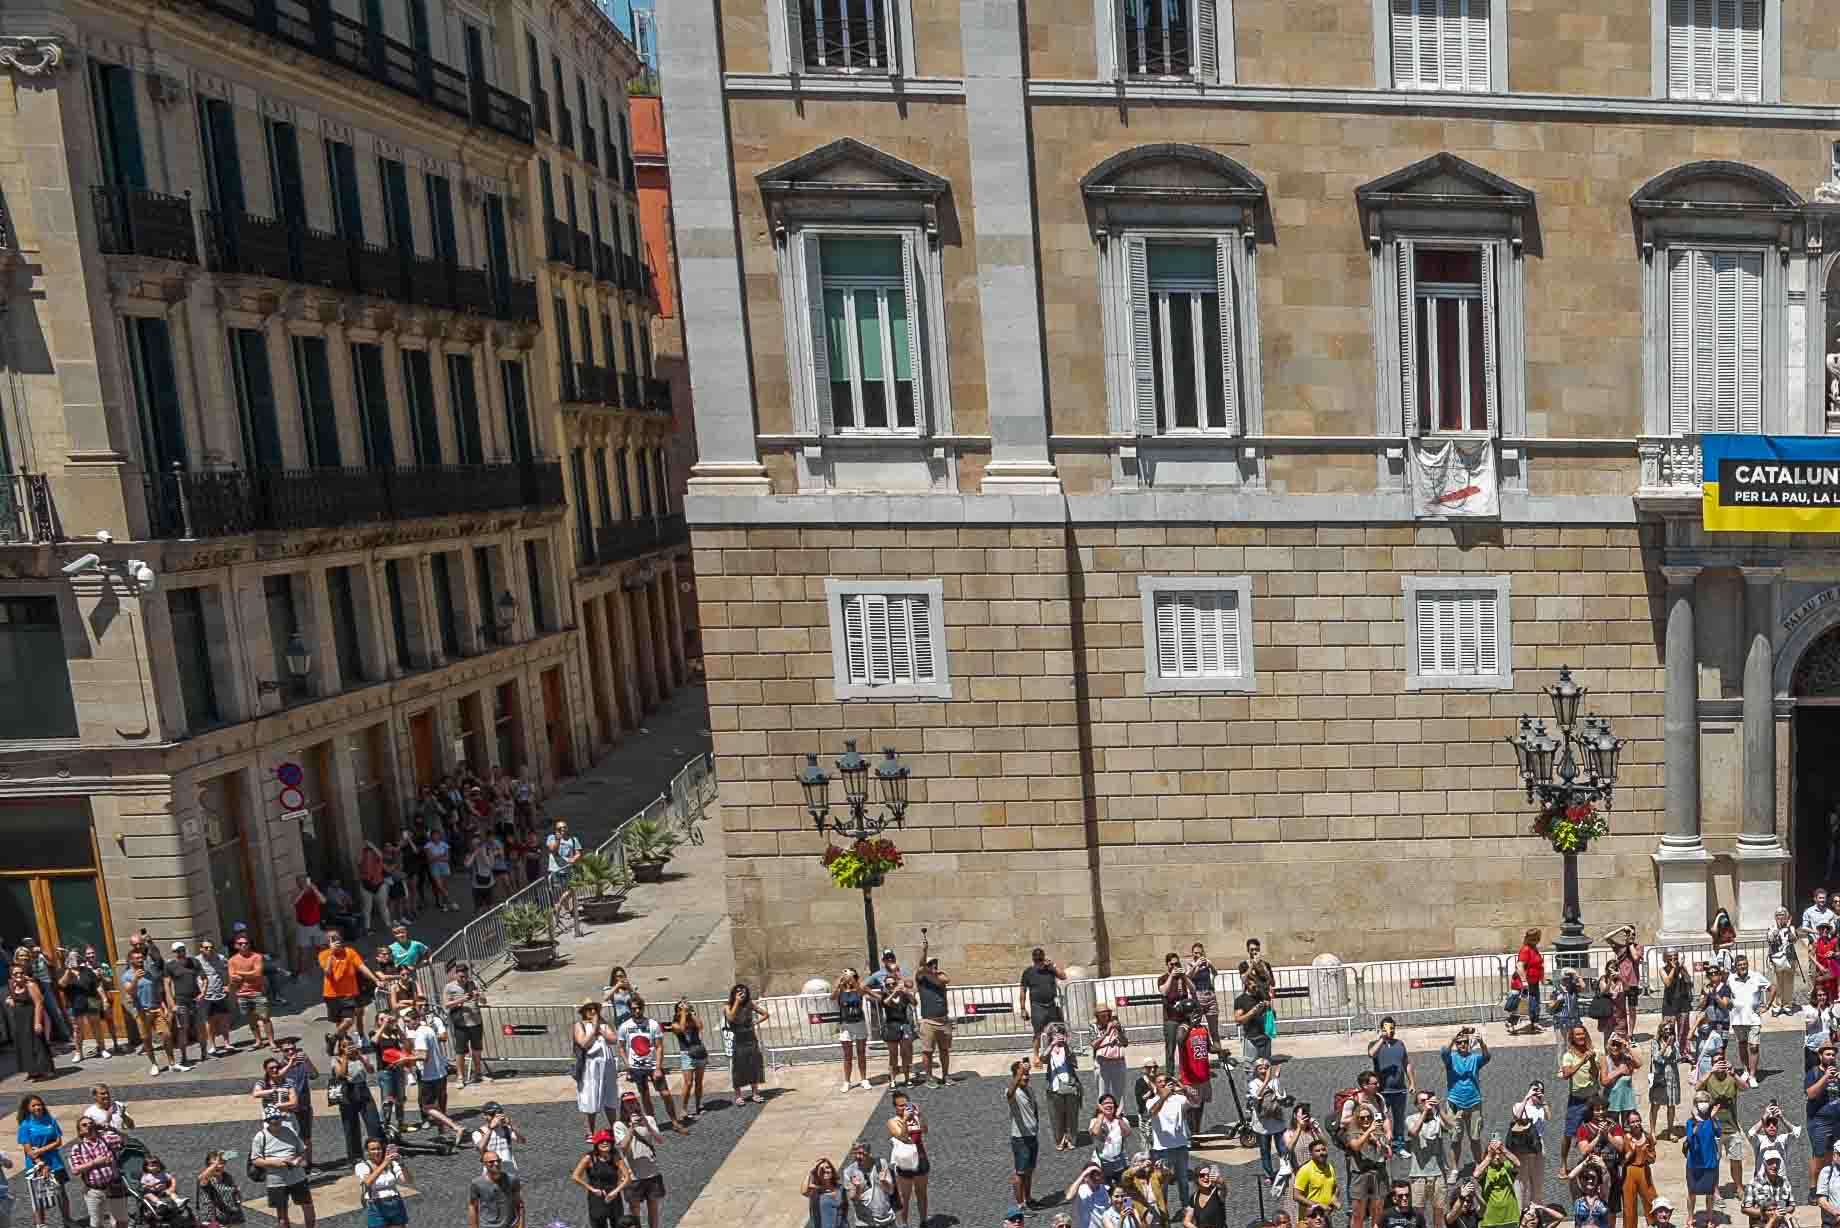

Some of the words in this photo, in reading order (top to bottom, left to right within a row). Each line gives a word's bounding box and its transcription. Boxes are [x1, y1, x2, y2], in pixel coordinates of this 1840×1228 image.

[1735, 490, 1759, 502] PER
[1762, 491, 1779, 502] LA
[1782, 491, 1810, 505] PAU,
[1813, 492, 1831, 504] LA
[1783, 597, 1816, 632] PALAU
[1818, 588, 1836, 605] DE
